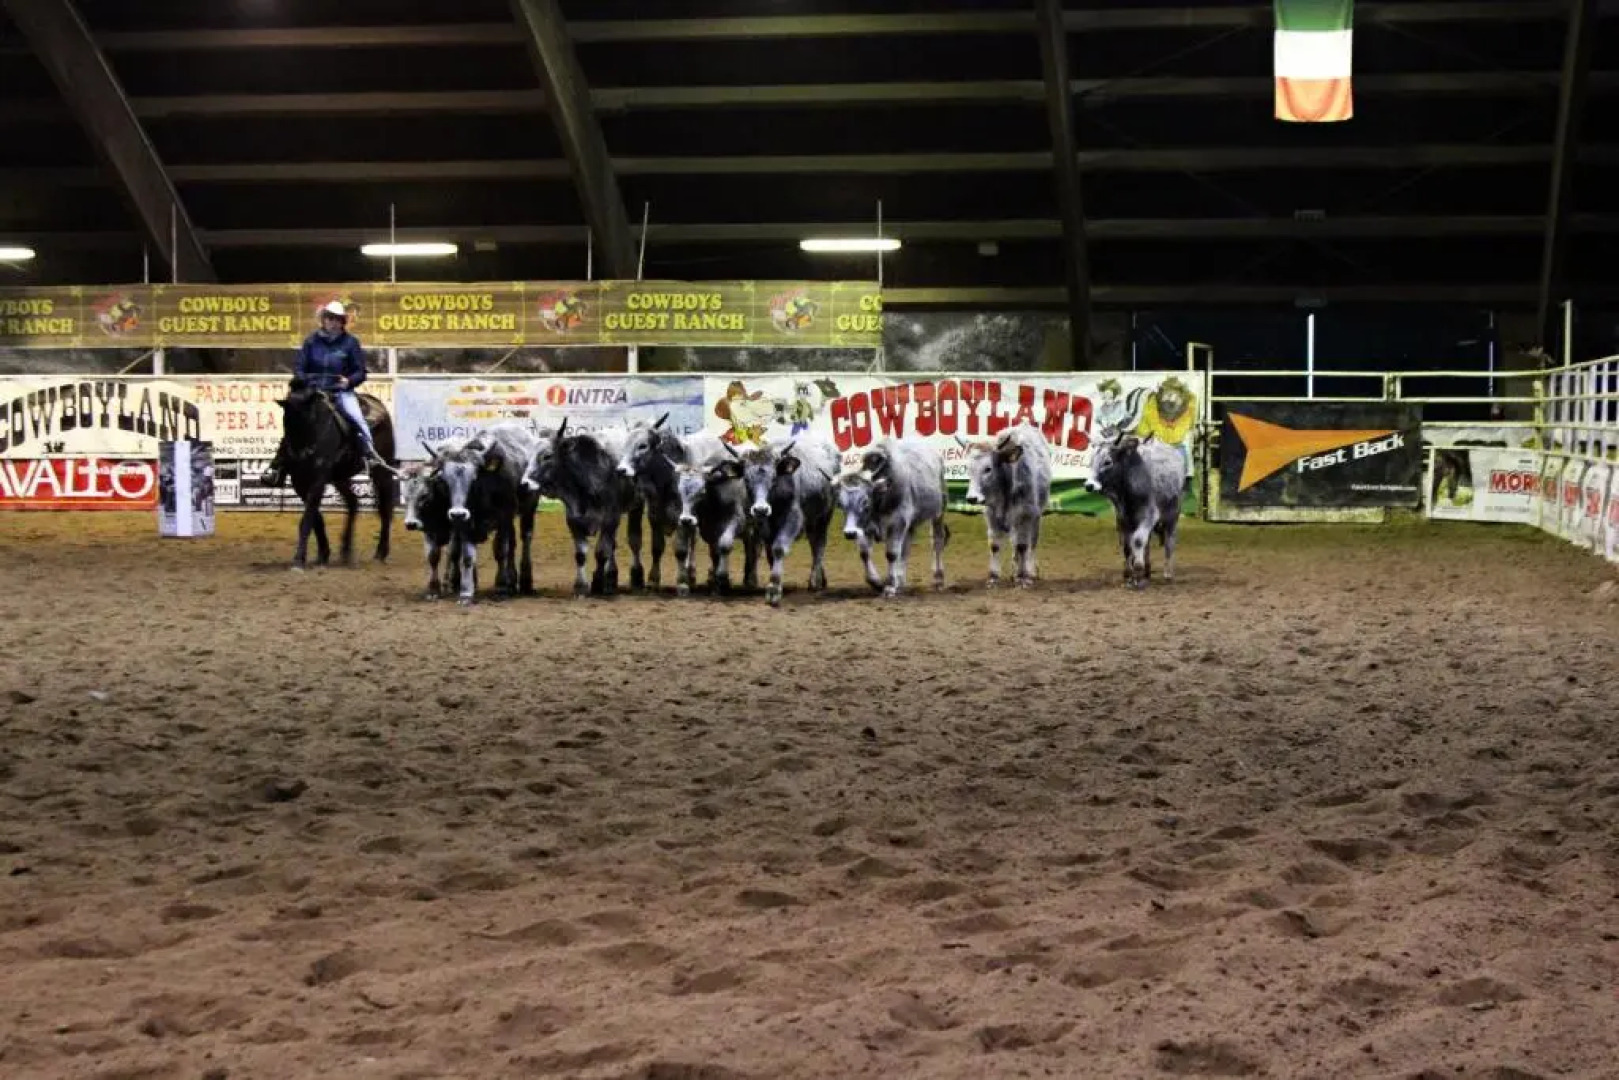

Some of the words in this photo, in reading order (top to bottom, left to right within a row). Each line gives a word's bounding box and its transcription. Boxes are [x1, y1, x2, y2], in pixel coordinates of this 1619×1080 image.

[179, 297, 270, 313] COWBOYS
[401, 294, 493, 311] COWBOYS
[627, 293, 722, 310] COWBOYS
[8, 318, 74, 334] RANCH
[159, 318, 223, 333] GUEST
[225, 316, 292, 332] RANCH
[379, 314, 442, 331] GUEST
[445, 313, 516, 330] RANCH
[605, 314, 669, 331] GUEST
[673, 313, 744, 331] RANCH
[195, 384, 252, 402] PARCO
[568, 388, 627, 404] INTRA
[215, 411, 248, 430] PER
[256, 411, 277, 430] LA
[831, 380, 1094, 452] COWBOYLAND
[1297, 449, 1347, 473] Fast
[1353, 433, 1404, 459] Back
